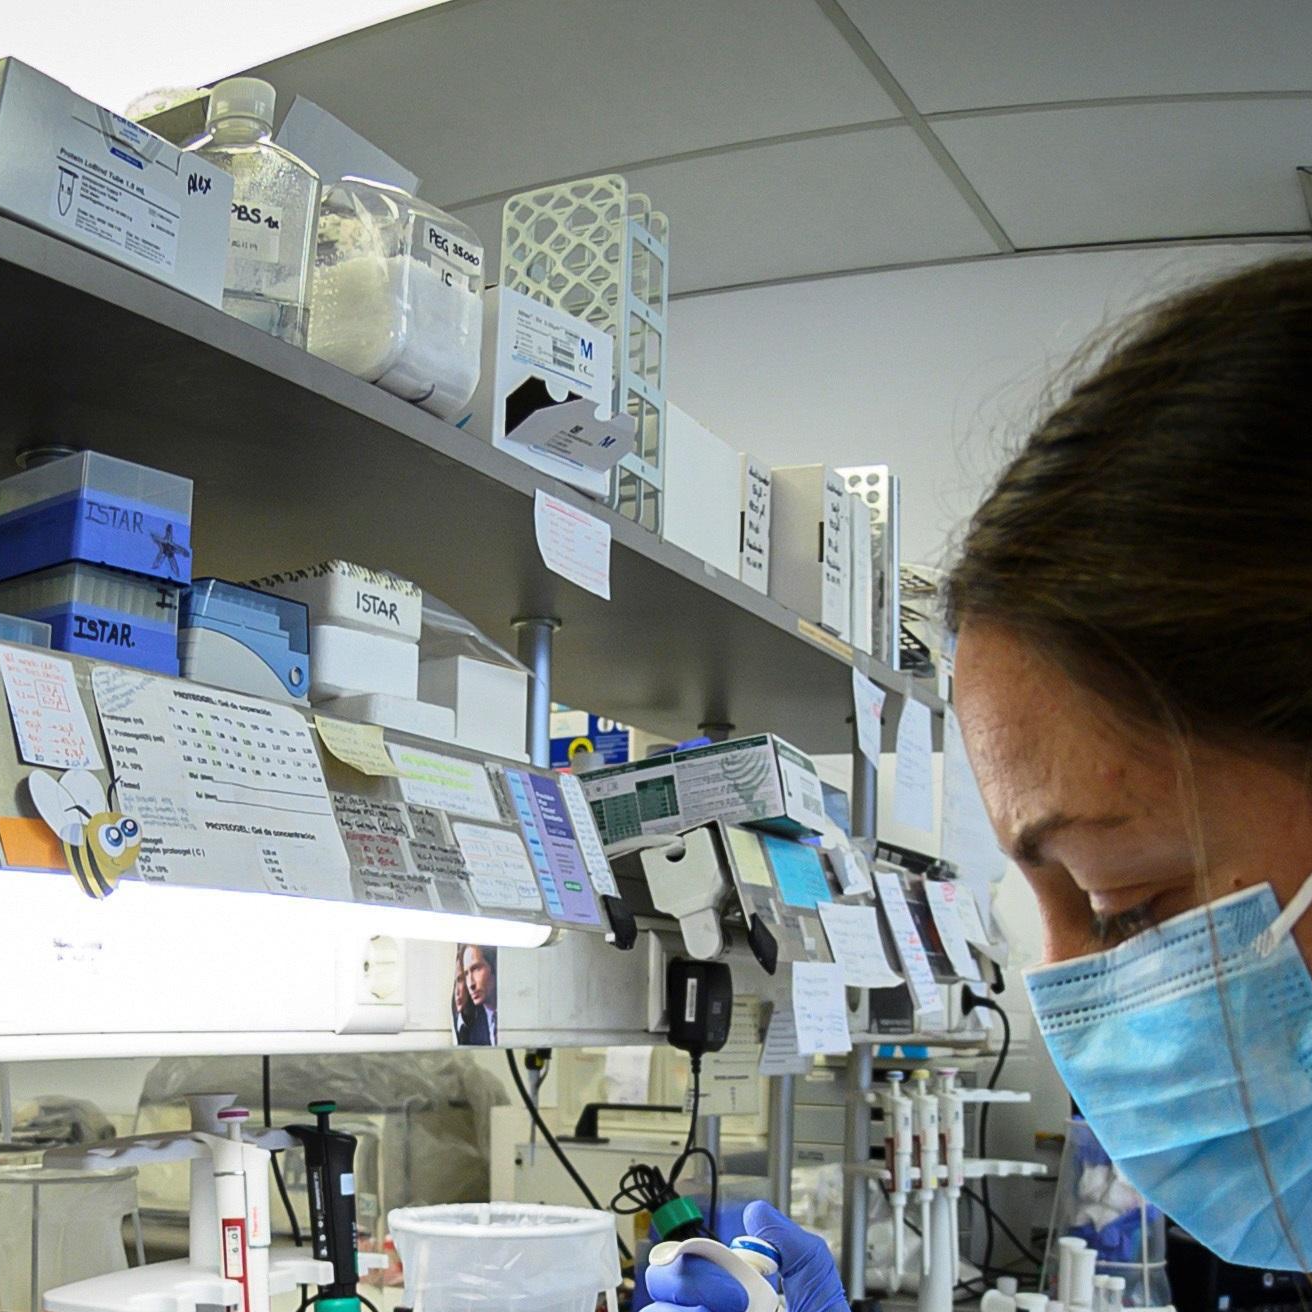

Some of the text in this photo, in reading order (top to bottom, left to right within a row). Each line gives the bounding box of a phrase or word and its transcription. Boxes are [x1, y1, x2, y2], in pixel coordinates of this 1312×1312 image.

[60, 148, 84, 165] Protein
[429, 228, 480, 266] PEG 35000
[85, 500, 144, 534] ISTAR
[356, 591, 400, 626] ISTAR
[73, 615, 136, 648] ISTAR.
